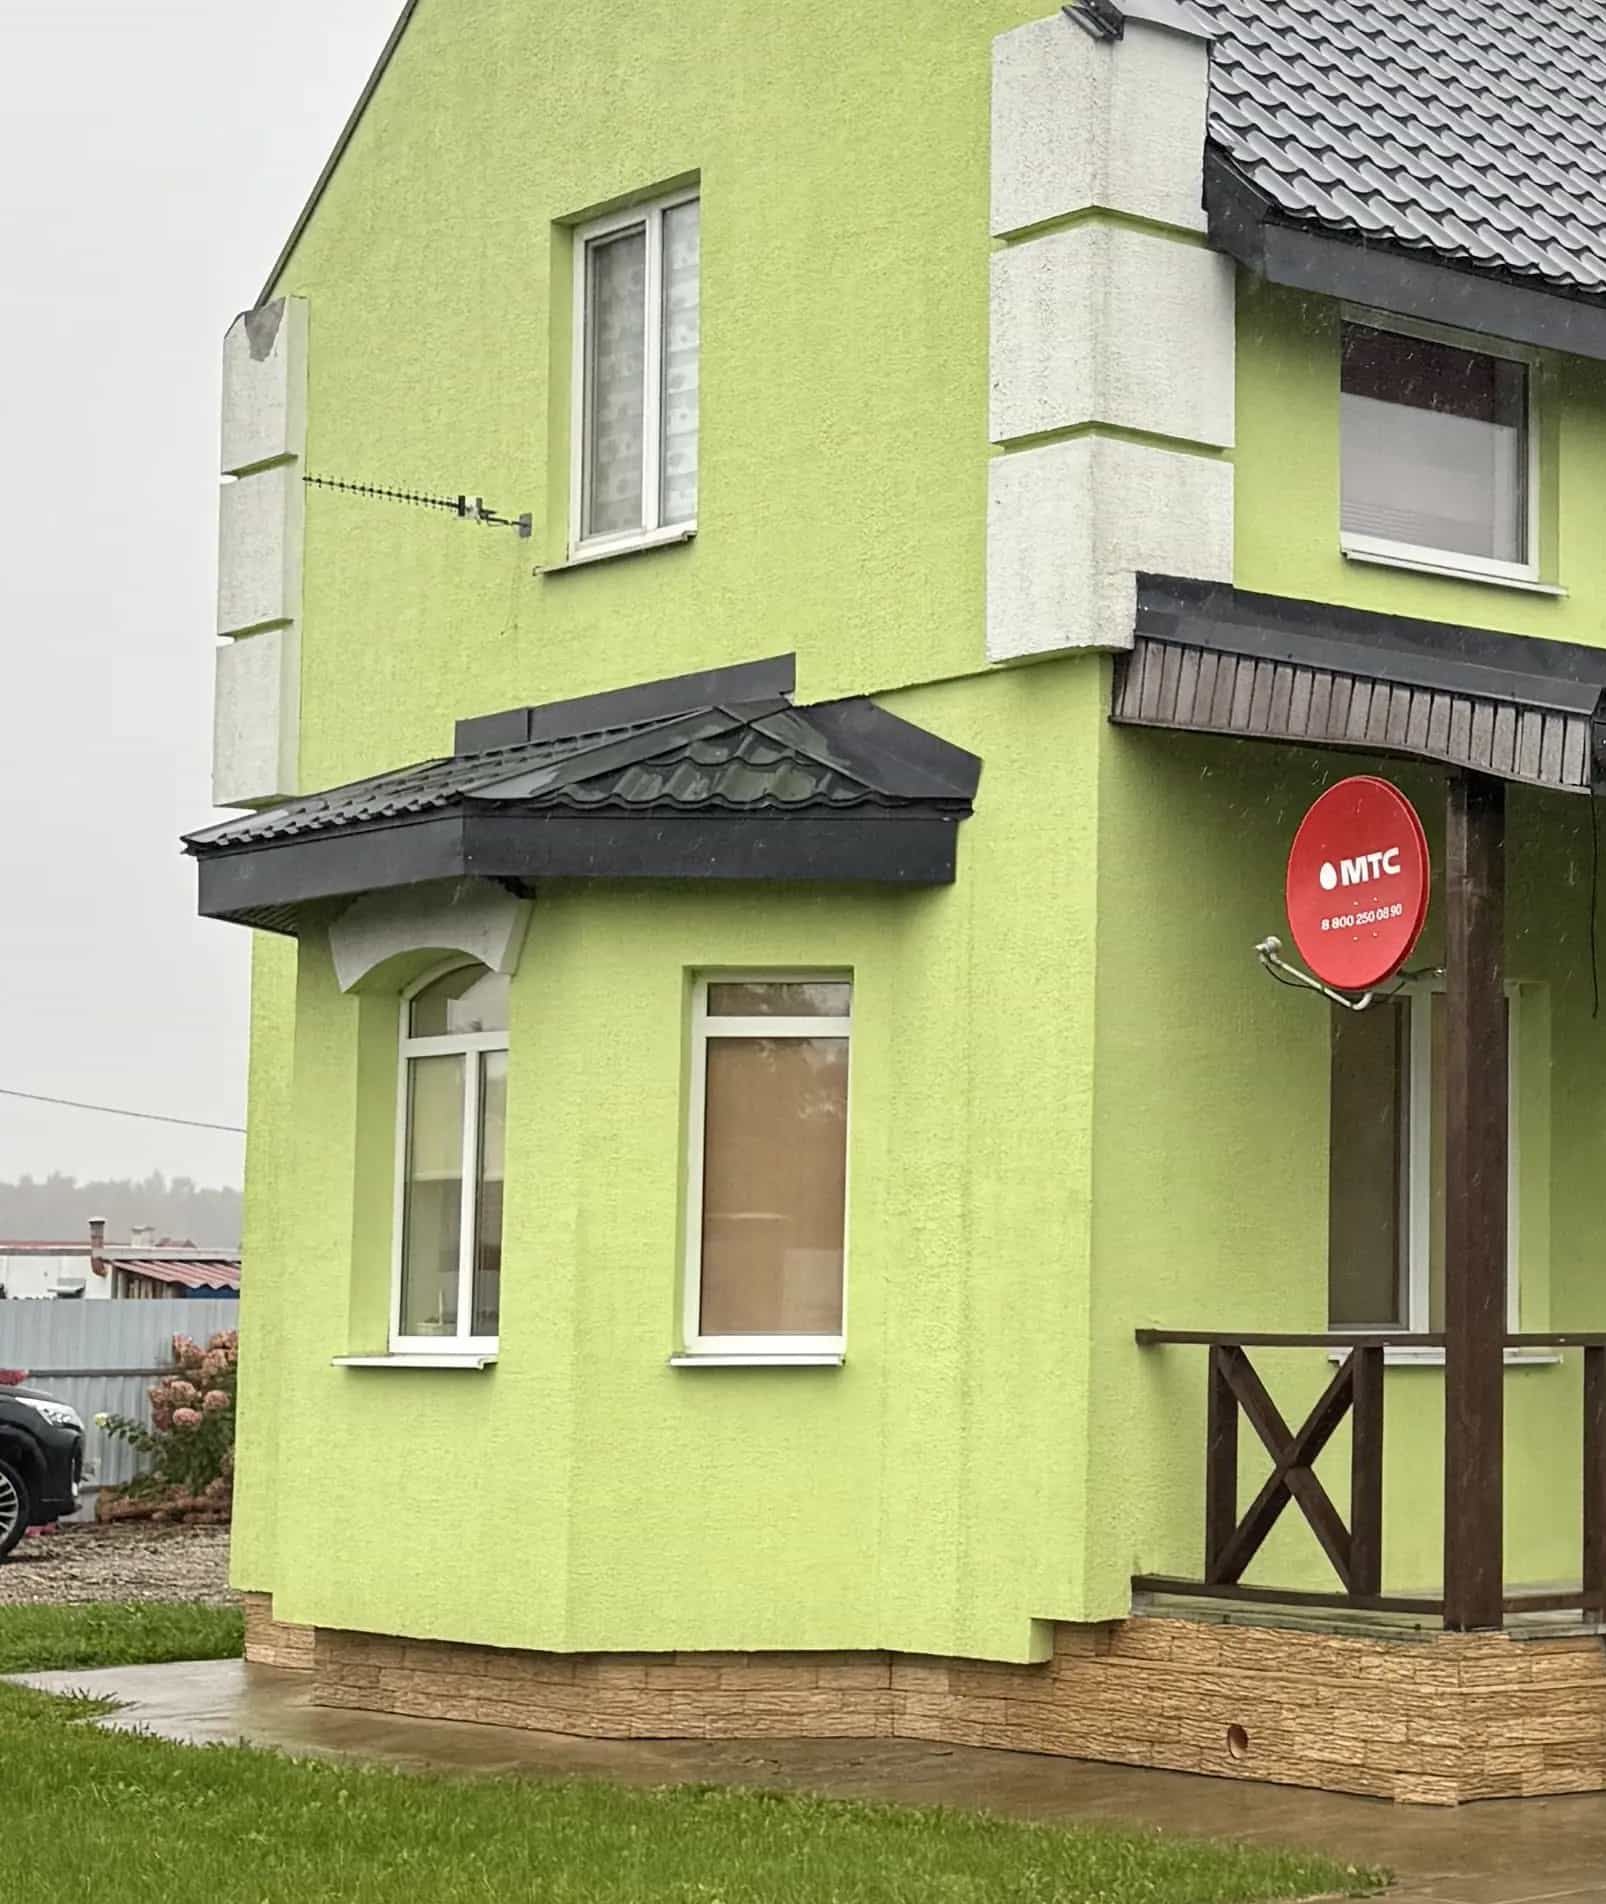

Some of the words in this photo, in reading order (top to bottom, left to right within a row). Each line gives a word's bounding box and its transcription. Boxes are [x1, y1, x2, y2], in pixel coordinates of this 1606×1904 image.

[1341, 847, 1401, 886] МТС
[1321, 919, 1330, 931] 8
[1331, 915, 1355, 928] 800
[1356, 911, 1375, 925] 250
[1390, 903, 1402, 917] 90
